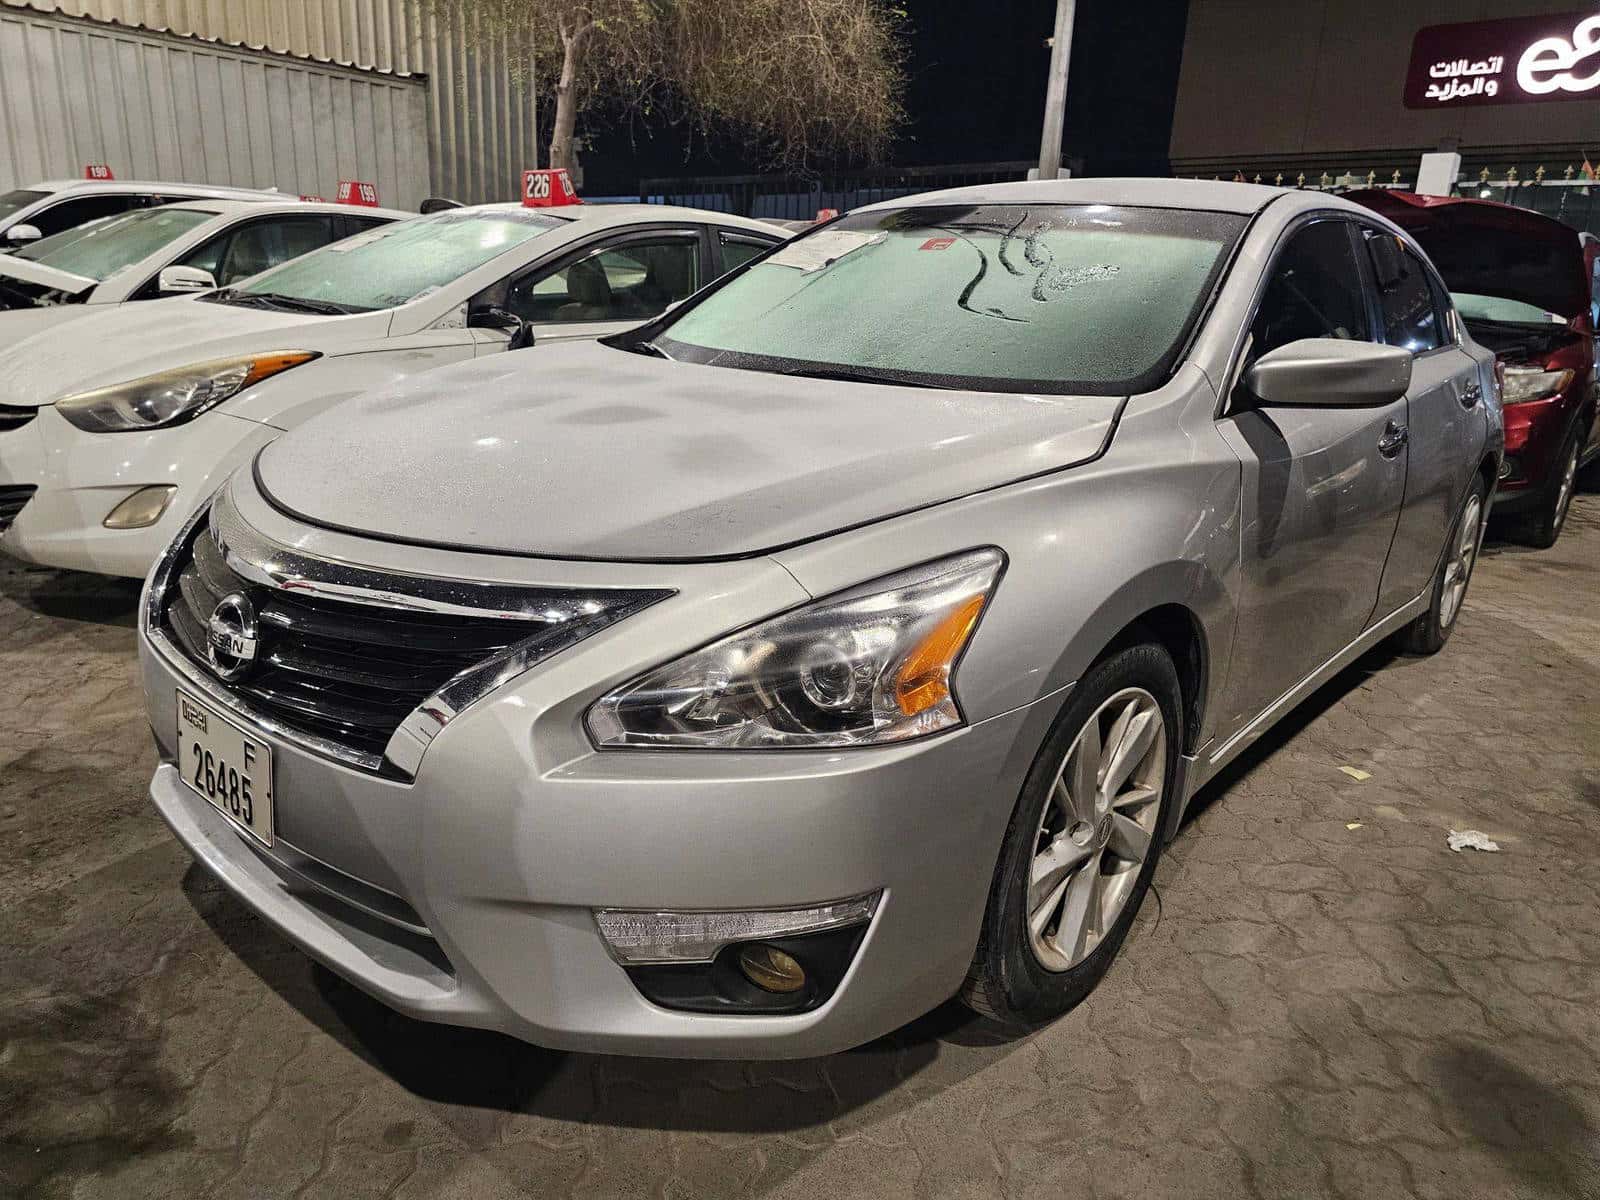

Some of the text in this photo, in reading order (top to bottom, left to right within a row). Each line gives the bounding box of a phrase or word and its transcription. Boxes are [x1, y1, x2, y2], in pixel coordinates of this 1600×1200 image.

[1429, 56, 1504, 78] اتصالات
[526, 173, 550, 199] 226
[243, 739, 256, 771] F
[193, 742, 254, 826] 26485
